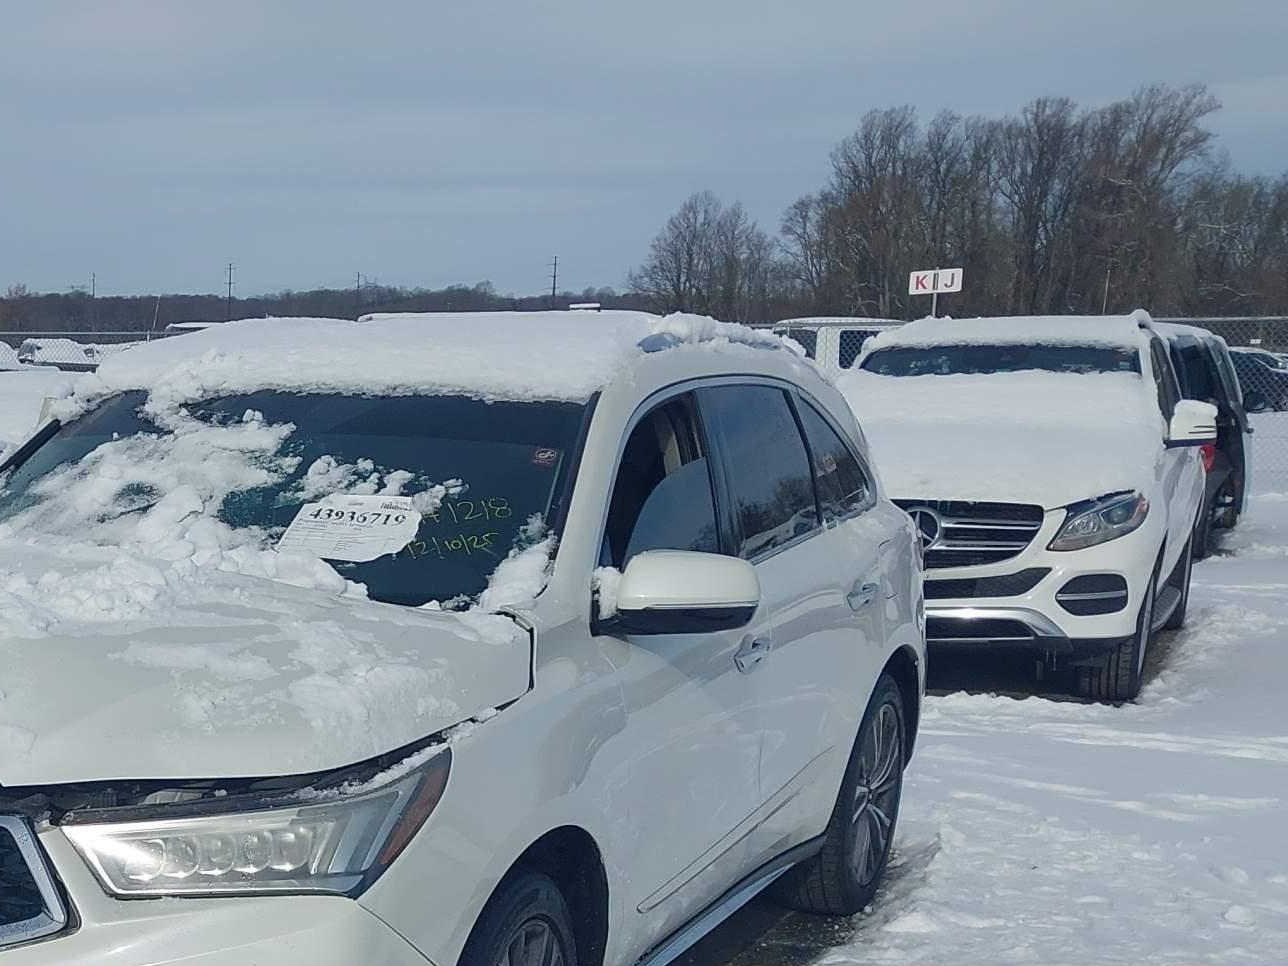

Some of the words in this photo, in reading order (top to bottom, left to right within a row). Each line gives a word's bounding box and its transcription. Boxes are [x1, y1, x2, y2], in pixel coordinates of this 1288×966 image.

[915, 275, 928, 290] K
[943, 272, 955, 288] J
[309, 507, 407, 526] 43936719
